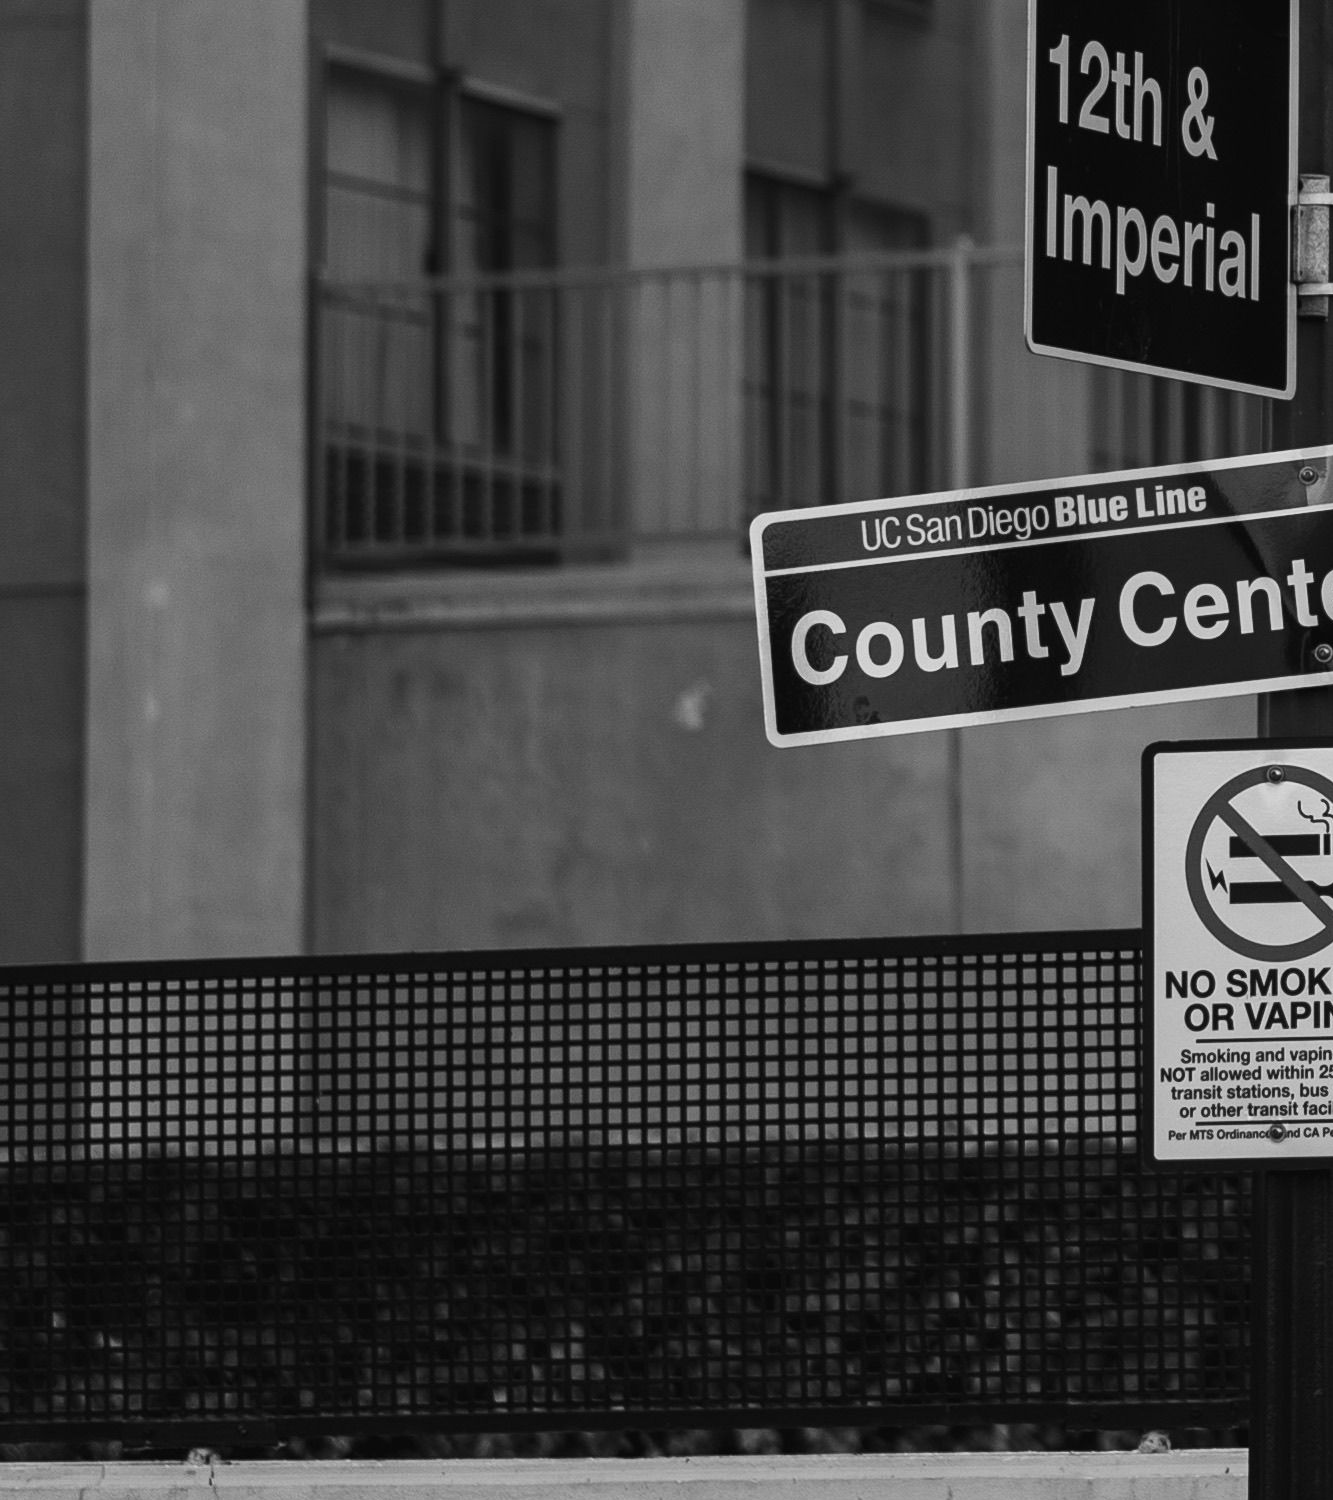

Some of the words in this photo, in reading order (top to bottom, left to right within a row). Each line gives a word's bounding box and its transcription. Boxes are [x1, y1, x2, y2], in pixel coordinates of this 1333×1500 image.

[1049, 34, 1162, 147] 12th
[1180, 66, 1218, 161] &
[1046, 166, 1260, 302] Imperial
[861, 517, 901, 551] UC
[905, 513, 962, 546] San
[967, 505, 1050, 540] Diego
[1054, 494, 1129, 528] Blue
[1135, 485, 1207, 518] Line
[791, 590, 1096, 686] County
[1165, 969, 1216, 999] NO
[1184, 1003, 1234, 1032] OR
[1180, 1048, 1251, 1065] Smoking
[1255, 1047, 1285, 1062] and
[1160, 1067, 1196, 1082] NOT
[1200, 1066, 1262, 1081] allowed
[1266, 1065, 1314, 1080] within
[1171, 1085, 1222, 1100] transit
[1226, 1084, 1295, 1100] stations,
[1300, 1083, 1329, 1097] bus
[1179, 1106, 1196, 1118] or
[1200, 1103, 1243, 1117] other
[1247, 1102, 1298, 1116] transit
[1168, 1130, 1186, 1141] Per
[1189, 1129, 1214, 1140] MTS
[1281, 1127, 1300, 1139] nd
[1303, 1126, 1320, 1138] CA
